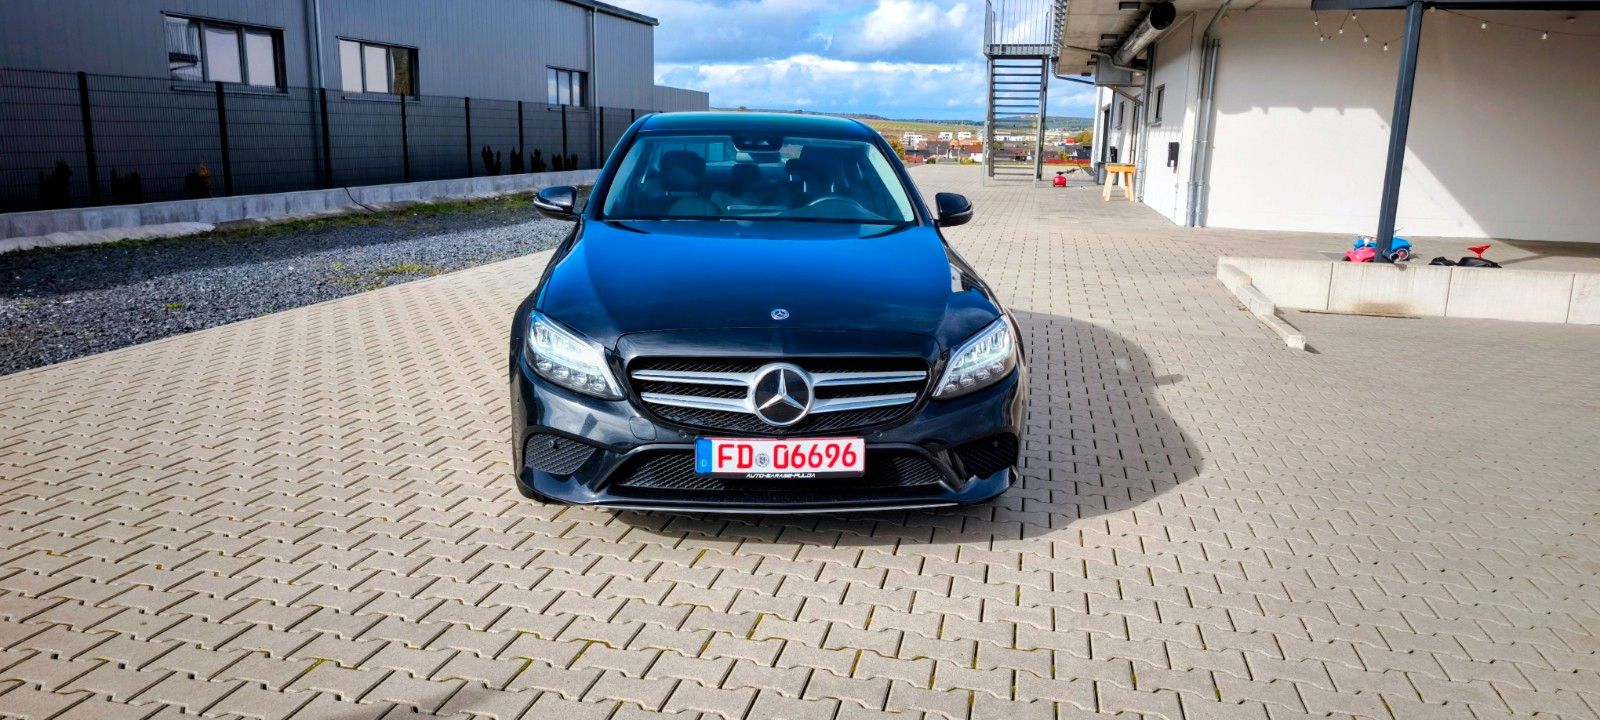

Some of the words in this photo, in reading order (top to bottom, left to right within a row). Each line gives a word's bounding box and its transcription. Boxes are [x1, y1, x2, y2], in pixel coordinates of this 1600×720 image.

[701, 459, 707, 467] D
[717, 443, 753, 469] FD
[773, 442, 857, 469] 06696
